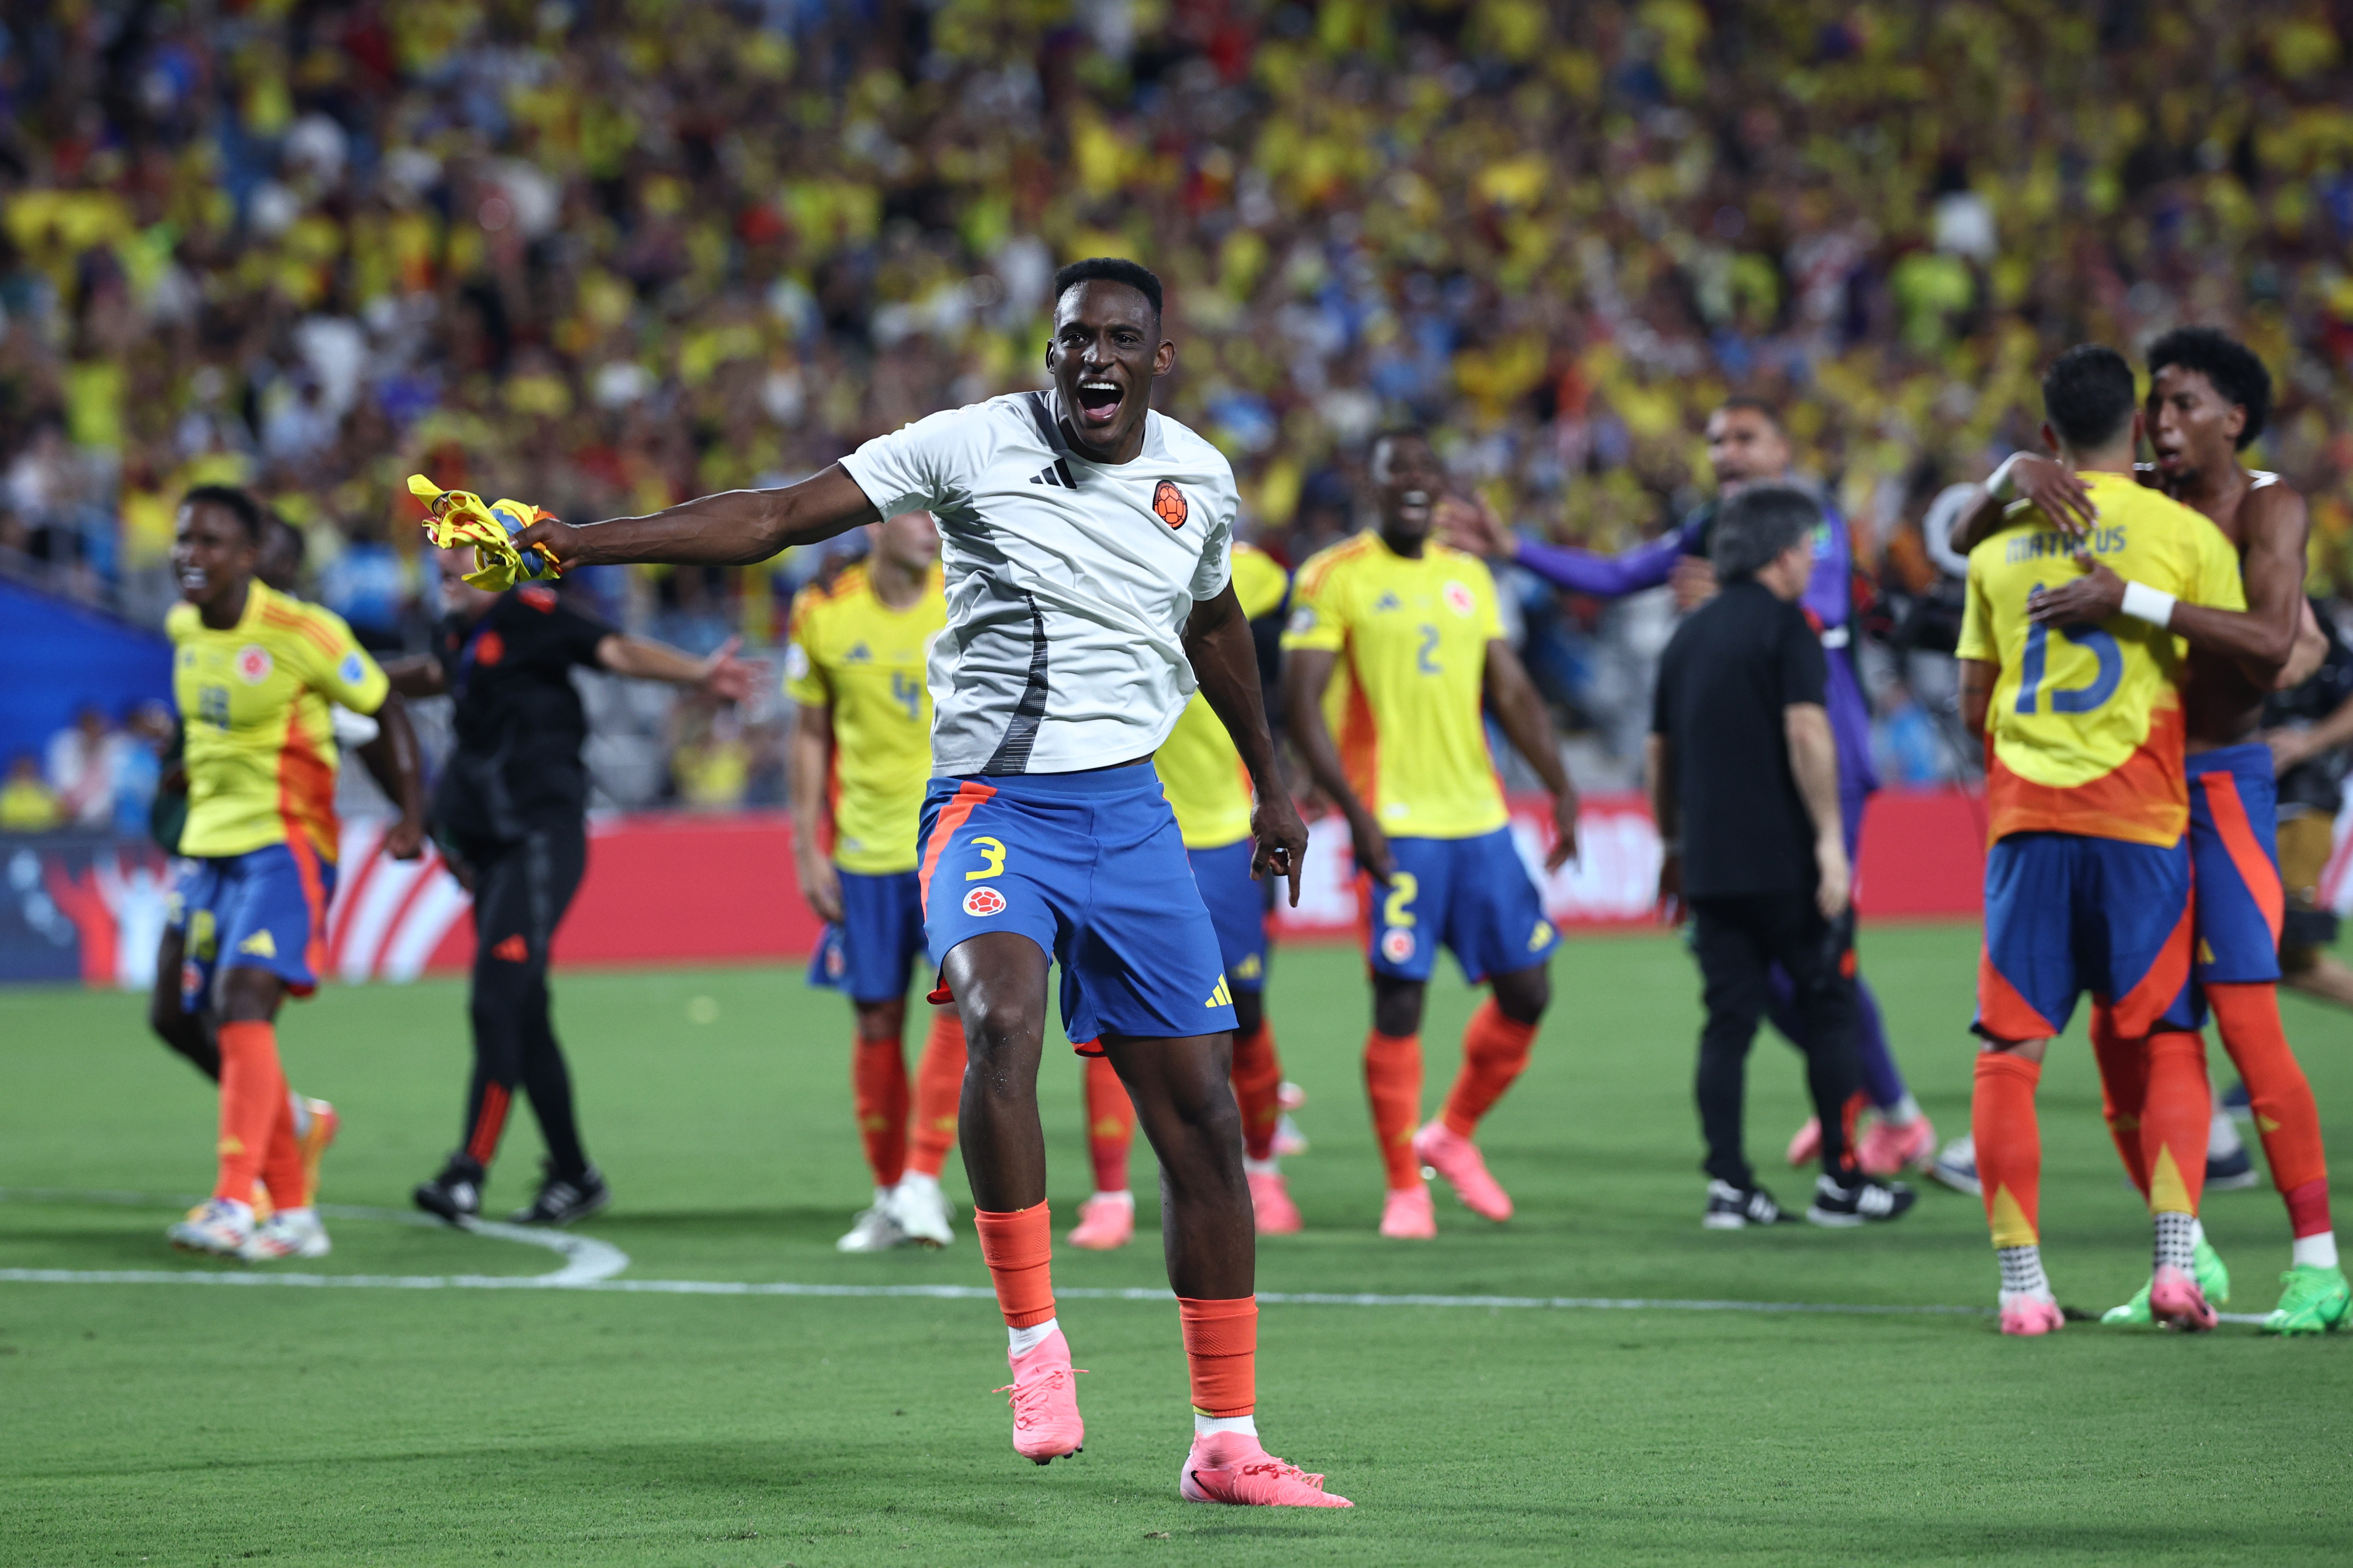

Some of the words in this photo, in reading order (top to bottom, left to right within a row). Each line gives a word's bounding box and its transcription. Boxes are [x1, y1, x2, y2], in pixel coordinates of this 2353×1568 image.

[1417, 623, 1444, 674] 2
[2015, 578, 2123, 715] 15
[893, 672, 920, 718] 4
[965, 836, 1006, 881] 3
[1384, 872, 1418, 927] 2
